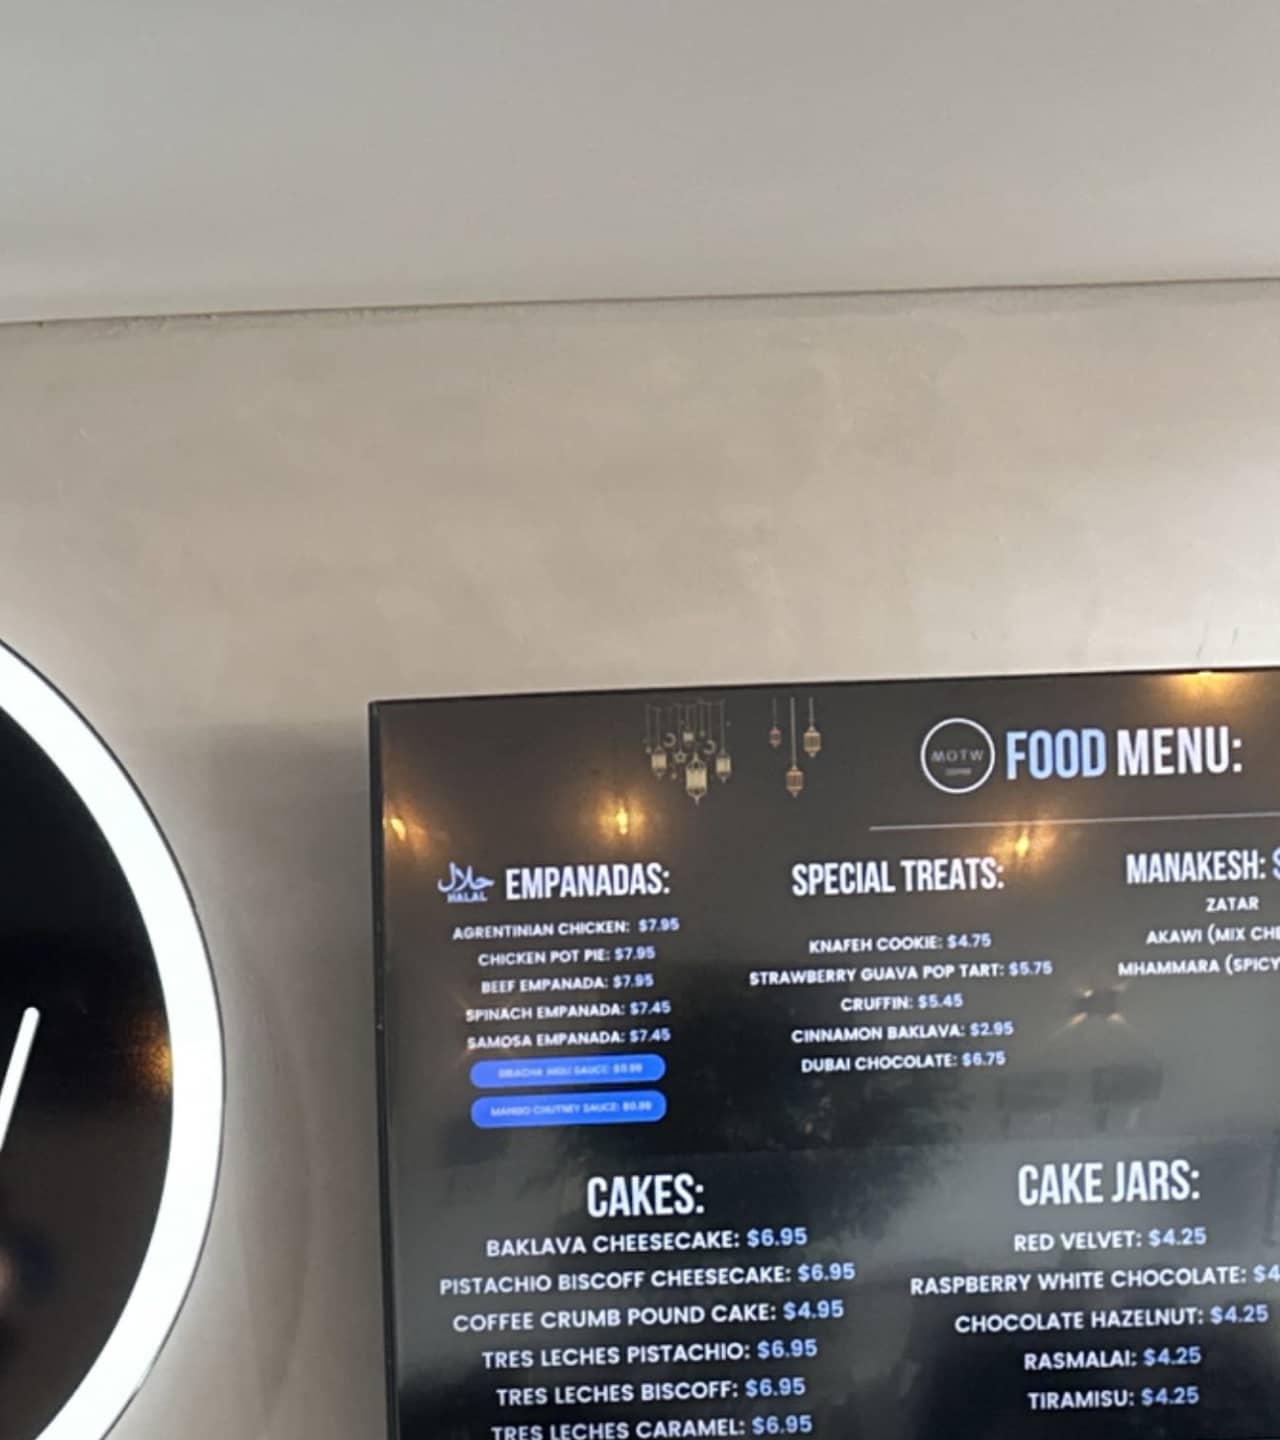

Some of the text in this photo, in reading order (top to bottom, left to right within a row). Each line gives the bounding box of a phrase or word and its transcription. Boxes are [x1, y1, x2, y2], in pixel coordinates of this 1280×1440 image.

[931, 749, 985, 763] MOTW
[1006, 726, 1242, 780] FOOD MENU:
[792, 856, 1004, 897] SPECIAL TREATS:
[1126, 850, 1266, 885] MANAKESH:
[506, 862, 671, 900] EMPANADAS:
[1206, 896, 1259, 912] ZATAR
[558, 920, 630, 936] CHICKEN:
[639, 917, 680, 933] $7.95
[809, 932, 992, 955] KNAFEH COOKIE: $4.75
[749, 960, 1053, 987] STRAWBERRY GUAVA POP TART: $5.75
[1118, 959, 1220, 977] MHAMMARA
[466, 1000, 671, 1022] SPINACH EMPANADA: $7.45
[841, 992, 963, 1013] CRUFFIN: $5.45
[801, 1050, 1006, 1074] DUBAI CHOCOLATE: $6.75
[1018, 1159, 1200, 1206] CAKE JARS:
[587, 1173, 704, 1218] CAKES:
[486, 1227, 808, 1257] BAKLAVA CHEESECAKE: $6.95
[1015, 1228, 1206, 1252] RED VELVET: $4.25
[910, 1266, 1246, 1295] RASPBERRY WHITE CHOCOLATE:
[453, 1300, 844, 1332] COFFEE CRUMB POUND CAKE: $4.95
[482, 1339, 818, 1369] TRES LECHES PISTACHIO: $6.95
[1024, 1347, 1201, 1370] RASMALAI: $4.25
[1027, 1386, 1199, 1410] TIRAMISU: $4.25
[550, 1423, 628, 1440] LECHES
[635, 1419, 745, 1438] CARAMEL:
[751, 1415, 812, 1435] $6.95
